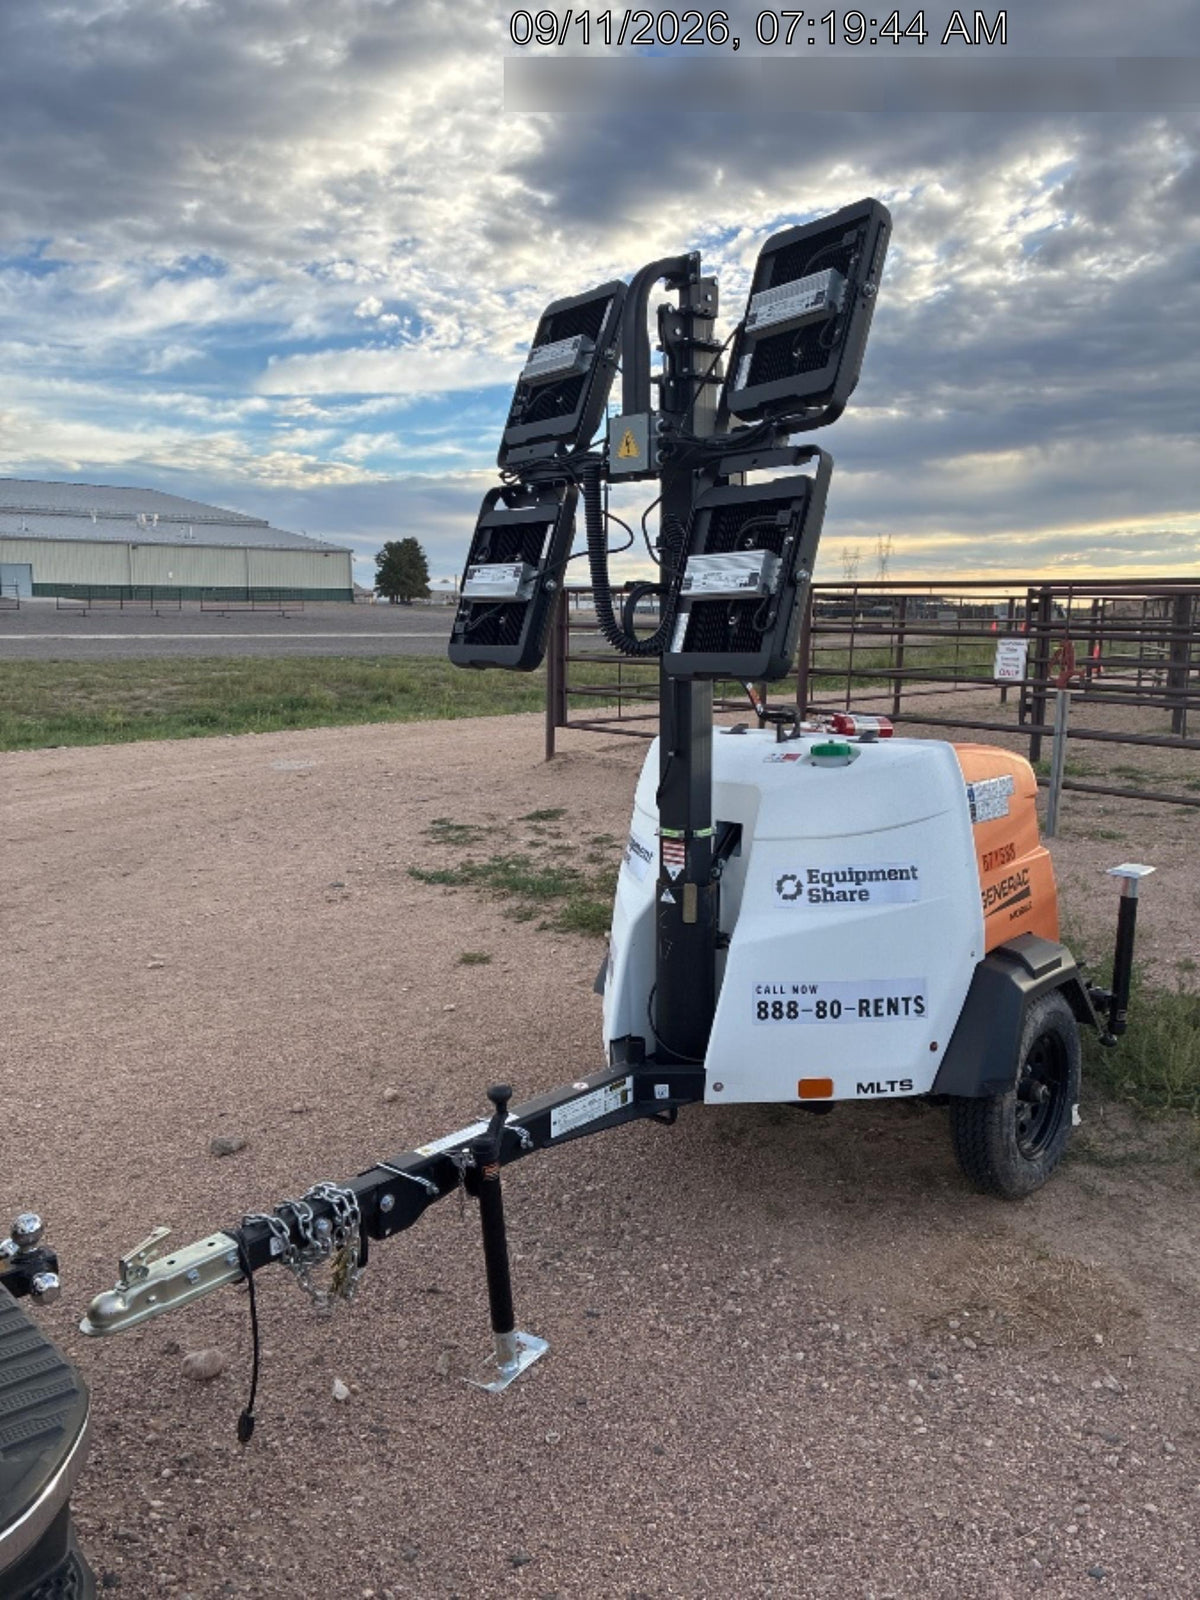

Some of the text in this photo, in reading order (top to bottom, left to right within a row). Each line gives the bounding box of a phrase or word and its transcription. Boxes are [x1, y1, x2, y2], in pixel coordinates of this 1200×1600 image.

[806, 865, 918, 888] Equipment
[807, 887, 870, 904] Share
[755, 984, 819, 995] CALL NOW
[756, 995, 926, 1021] 888-80-RENTS
[856, 1078, 914, 1096] MLTS
